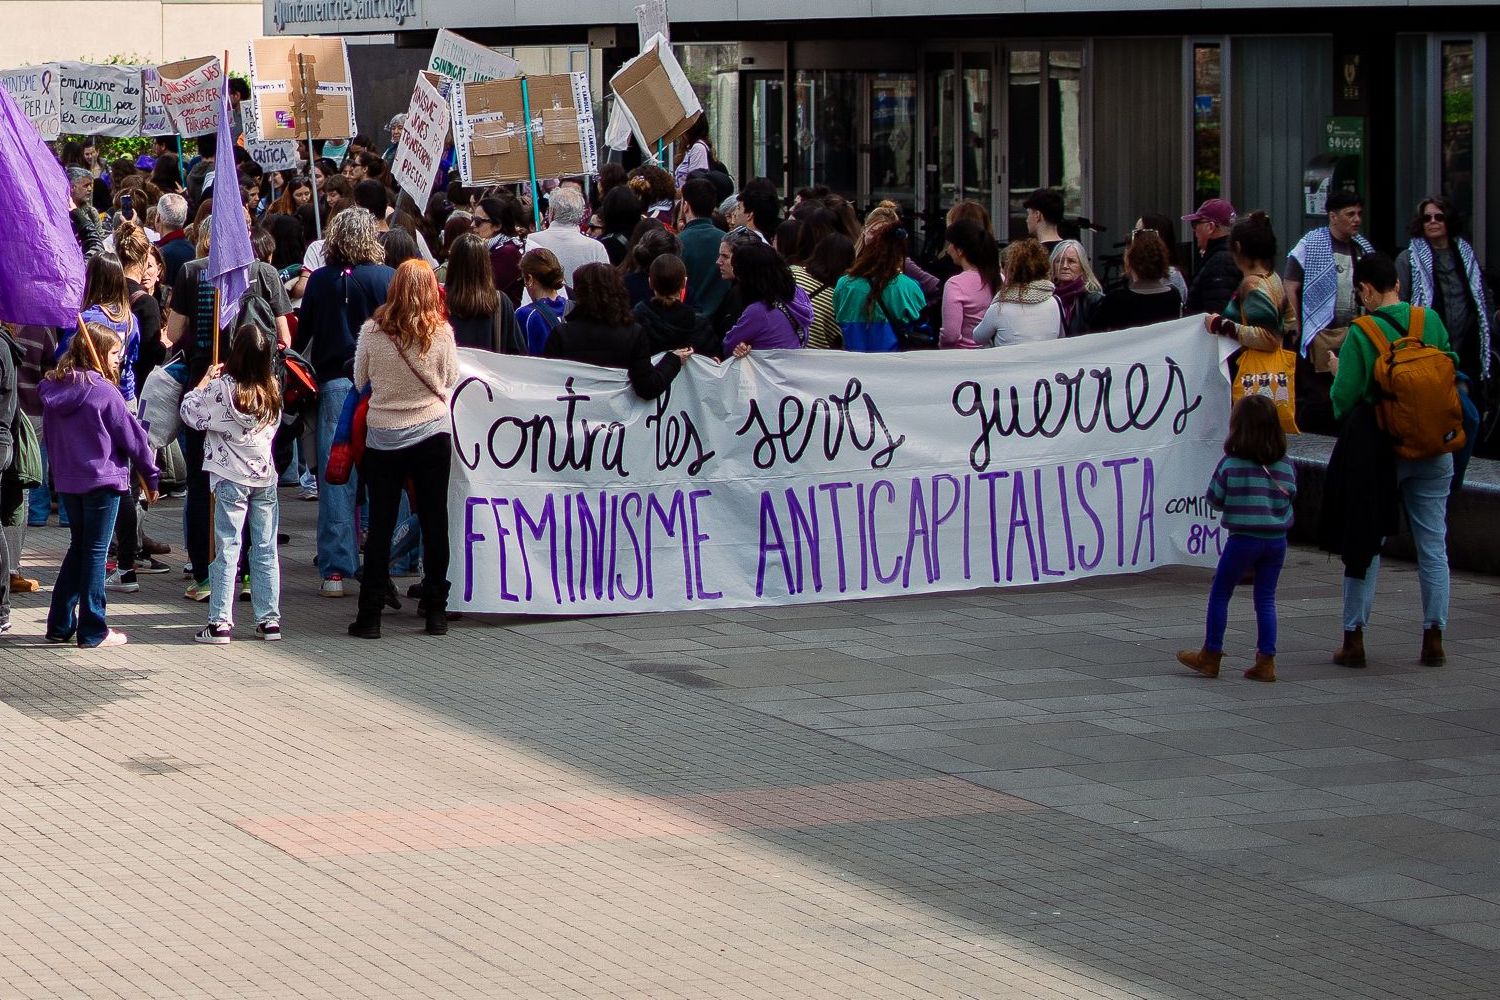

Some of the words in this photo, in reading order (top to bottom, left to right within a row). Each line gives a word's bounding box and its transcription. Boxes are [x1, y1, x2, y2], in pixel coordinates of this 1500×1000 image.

[201, 63, 220, 81] DES
[431, 56, 467, 83] SINDICAT
[1, 74, 38, 94] MINISME
[60, 77, 116, 92] eminisme
[123, 78, 140, 95] des
[24, 100, 41, 117] PER
[44, 99, 56, 115] LA
[114, 101, 137, 115] per
[160, 93, 173, 106] DE
[81, 113, 138, 126] coeducació
[184, 114, 220, 134] PATRIARC
[589, 135, 597, 159] LAMOLLA,
[450, 376, 630, 477] Contra
[645, 383, 716, 477] les
[952, 356, 1203, 472] guerres
[464, 489, 723, 604] FEMINISME
[756, 457, 1155, 597] ANTICAPITALISTA
[1187, 523, 1222, 556] 8M
